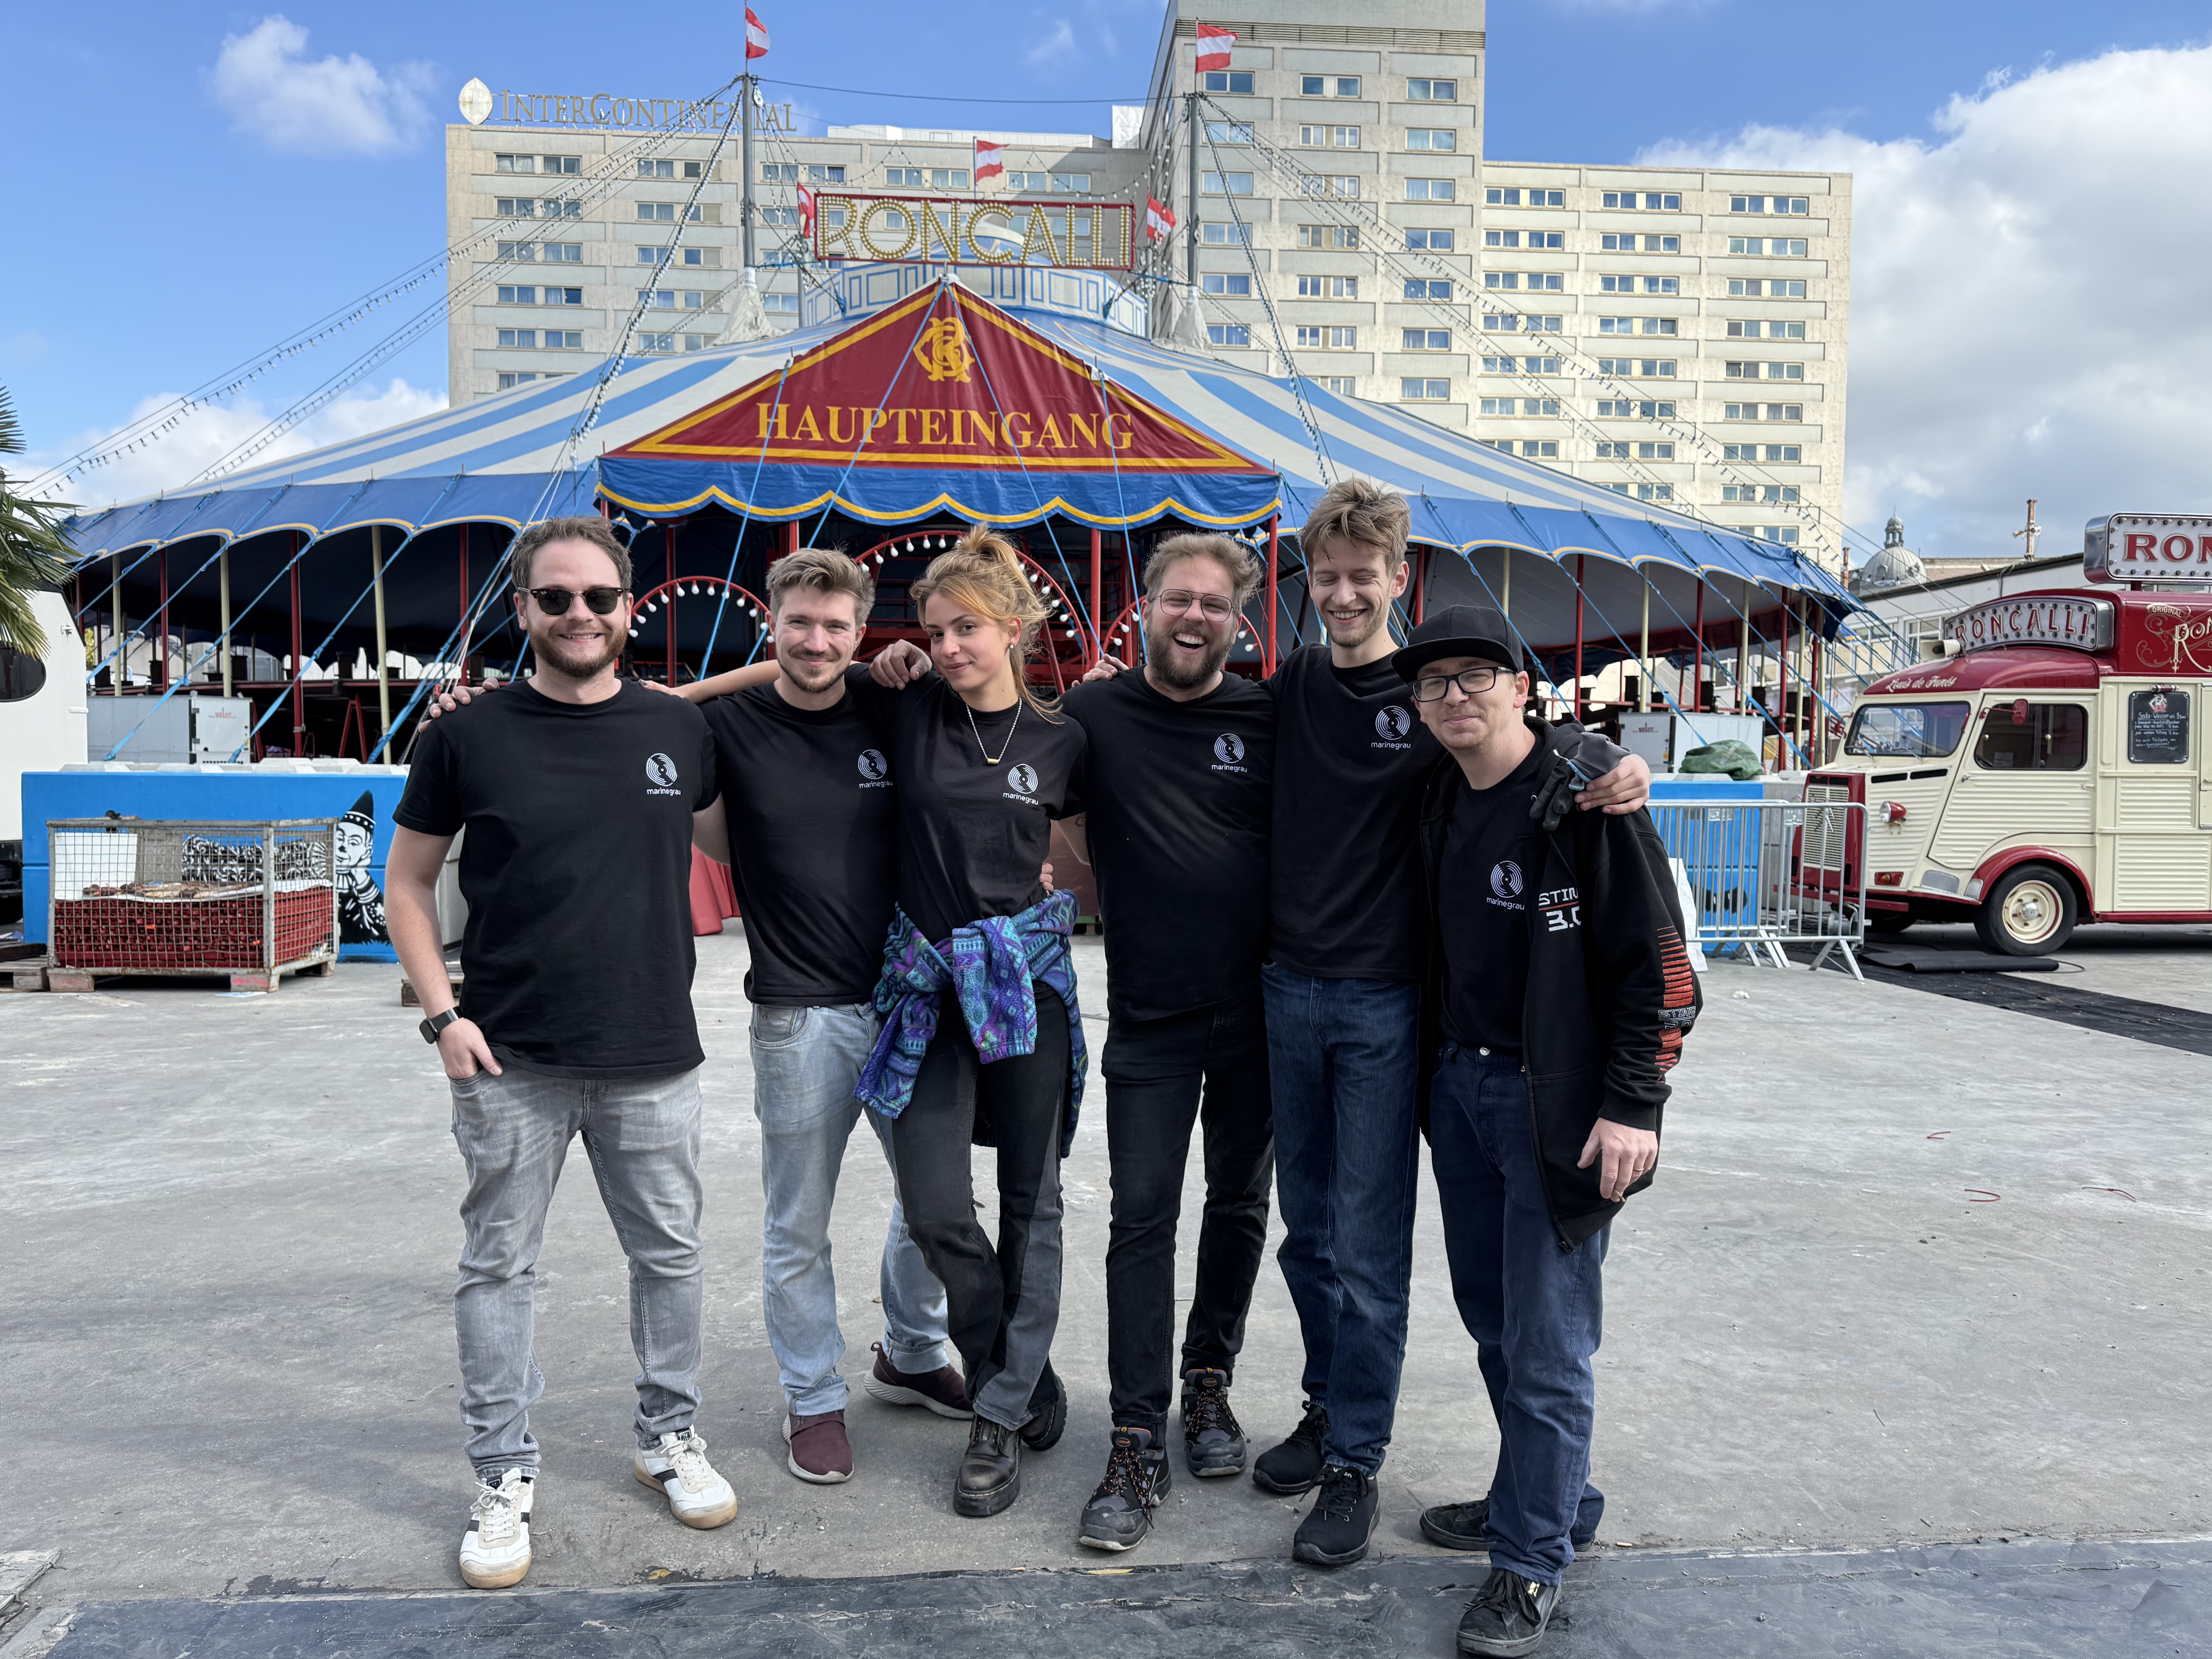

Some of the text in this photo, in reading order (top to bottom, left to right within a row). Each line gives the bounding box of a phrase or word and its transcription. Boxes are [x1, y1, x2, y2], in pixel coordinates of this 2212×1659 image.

[819, 196, 1129, 268] RONCALLI
[756, 402, 1134, 449] HAUPTEINGANG
[2152, 606, 2181, 618] ORIGINAL
[1955, 608, 2090, 643] RONCALLI
[1886, 677, 1912, 693] Louis
[1912, 677, 1925, 689] de
[1371, 741, 1411, 750] marinegrau
[1211, 764, 1247, 773] marinegrau
[646, 787, 681, 796] marinegrau
[1003, 793, 1039, 805] marinegrau
[1486, 896, 1525, 910] marinegrau
